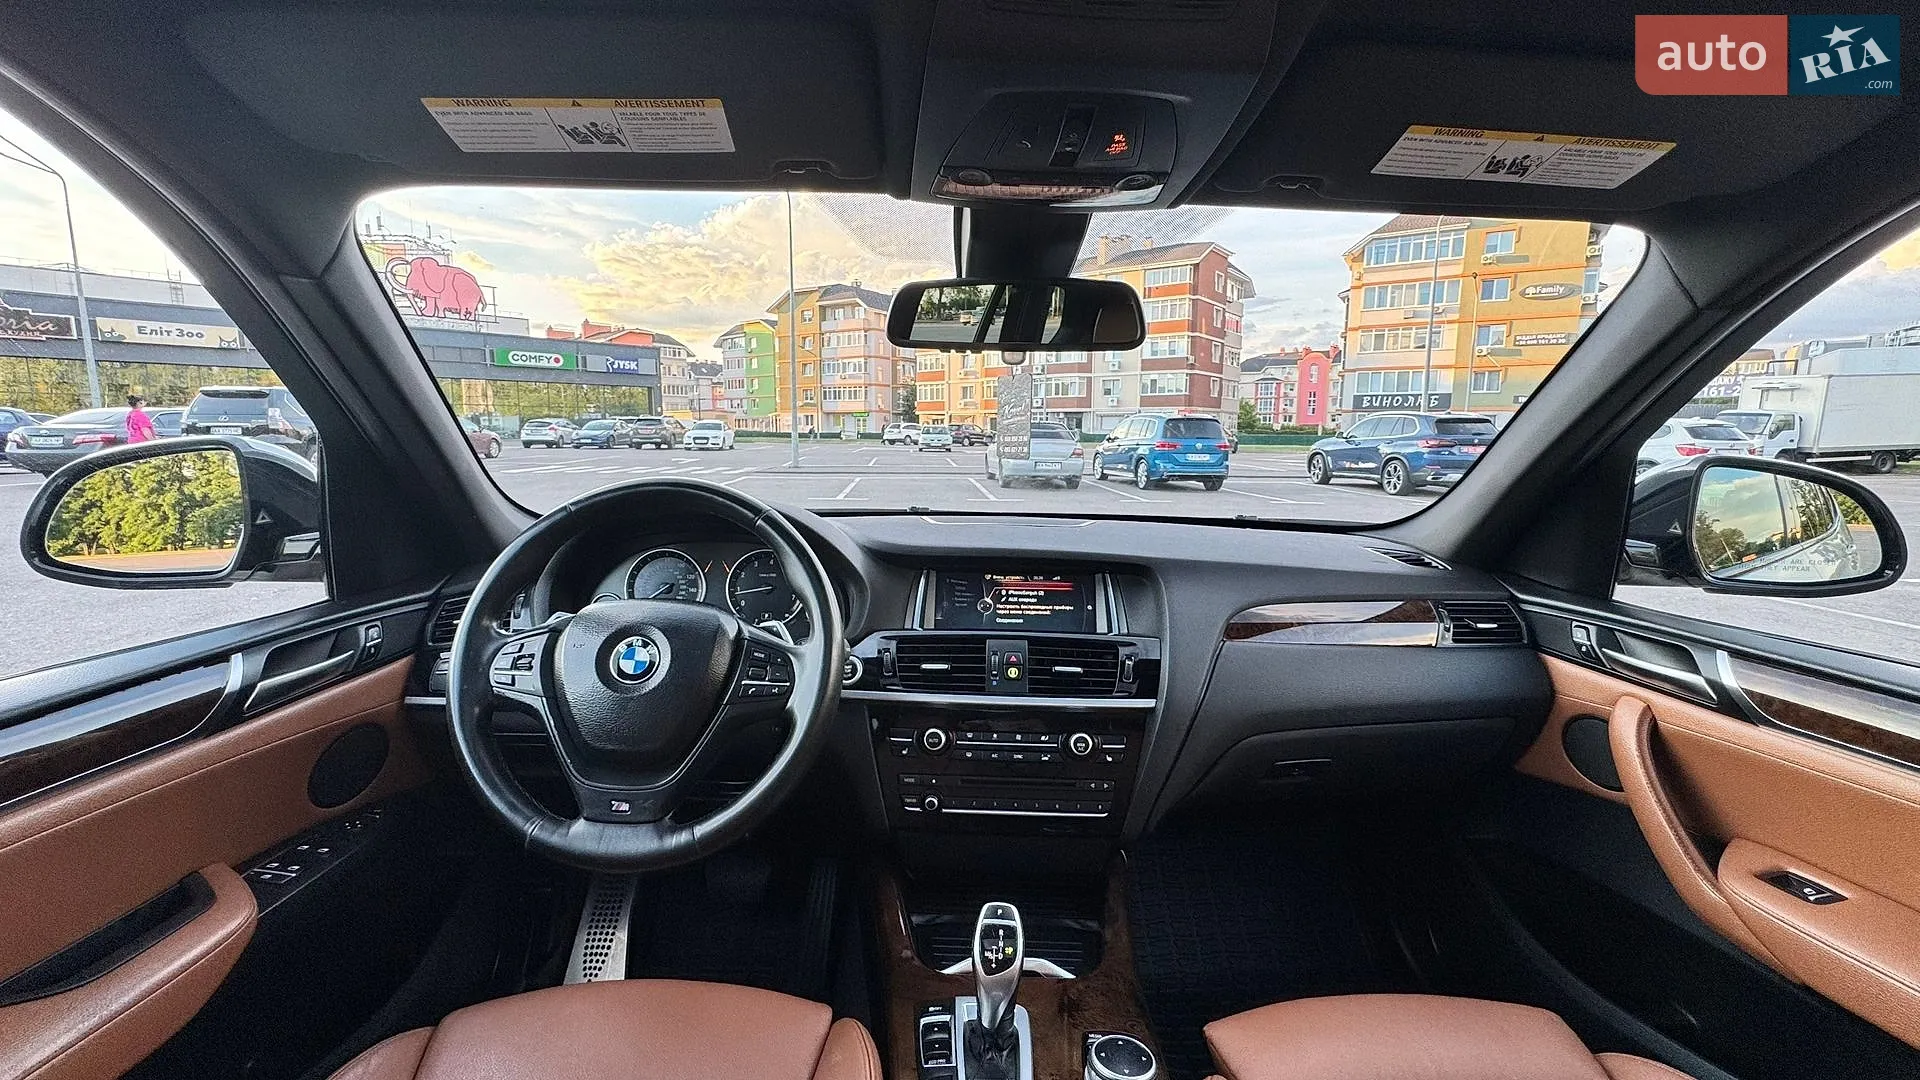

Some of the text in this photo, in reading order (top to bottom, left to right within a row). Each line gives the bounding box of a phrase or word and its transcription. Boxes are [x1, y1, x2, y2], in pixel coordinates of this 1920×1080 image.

[451, 98, 512, 108] WARNING
[614, 99, 706, 109] AVERTISSEMENT
[1432, 127, 1486, 139] WARNING
[1573, 137, 1661, 150] AVERTISSEMENT
[1535, 285, 1565, 295] Family
[136, 325, 205, 339] Еліт Зоо
[511, 353, 553, 365] COMFY
[612, 359, 638, 371] JYSK
[998, 952, 1004, 960] D
